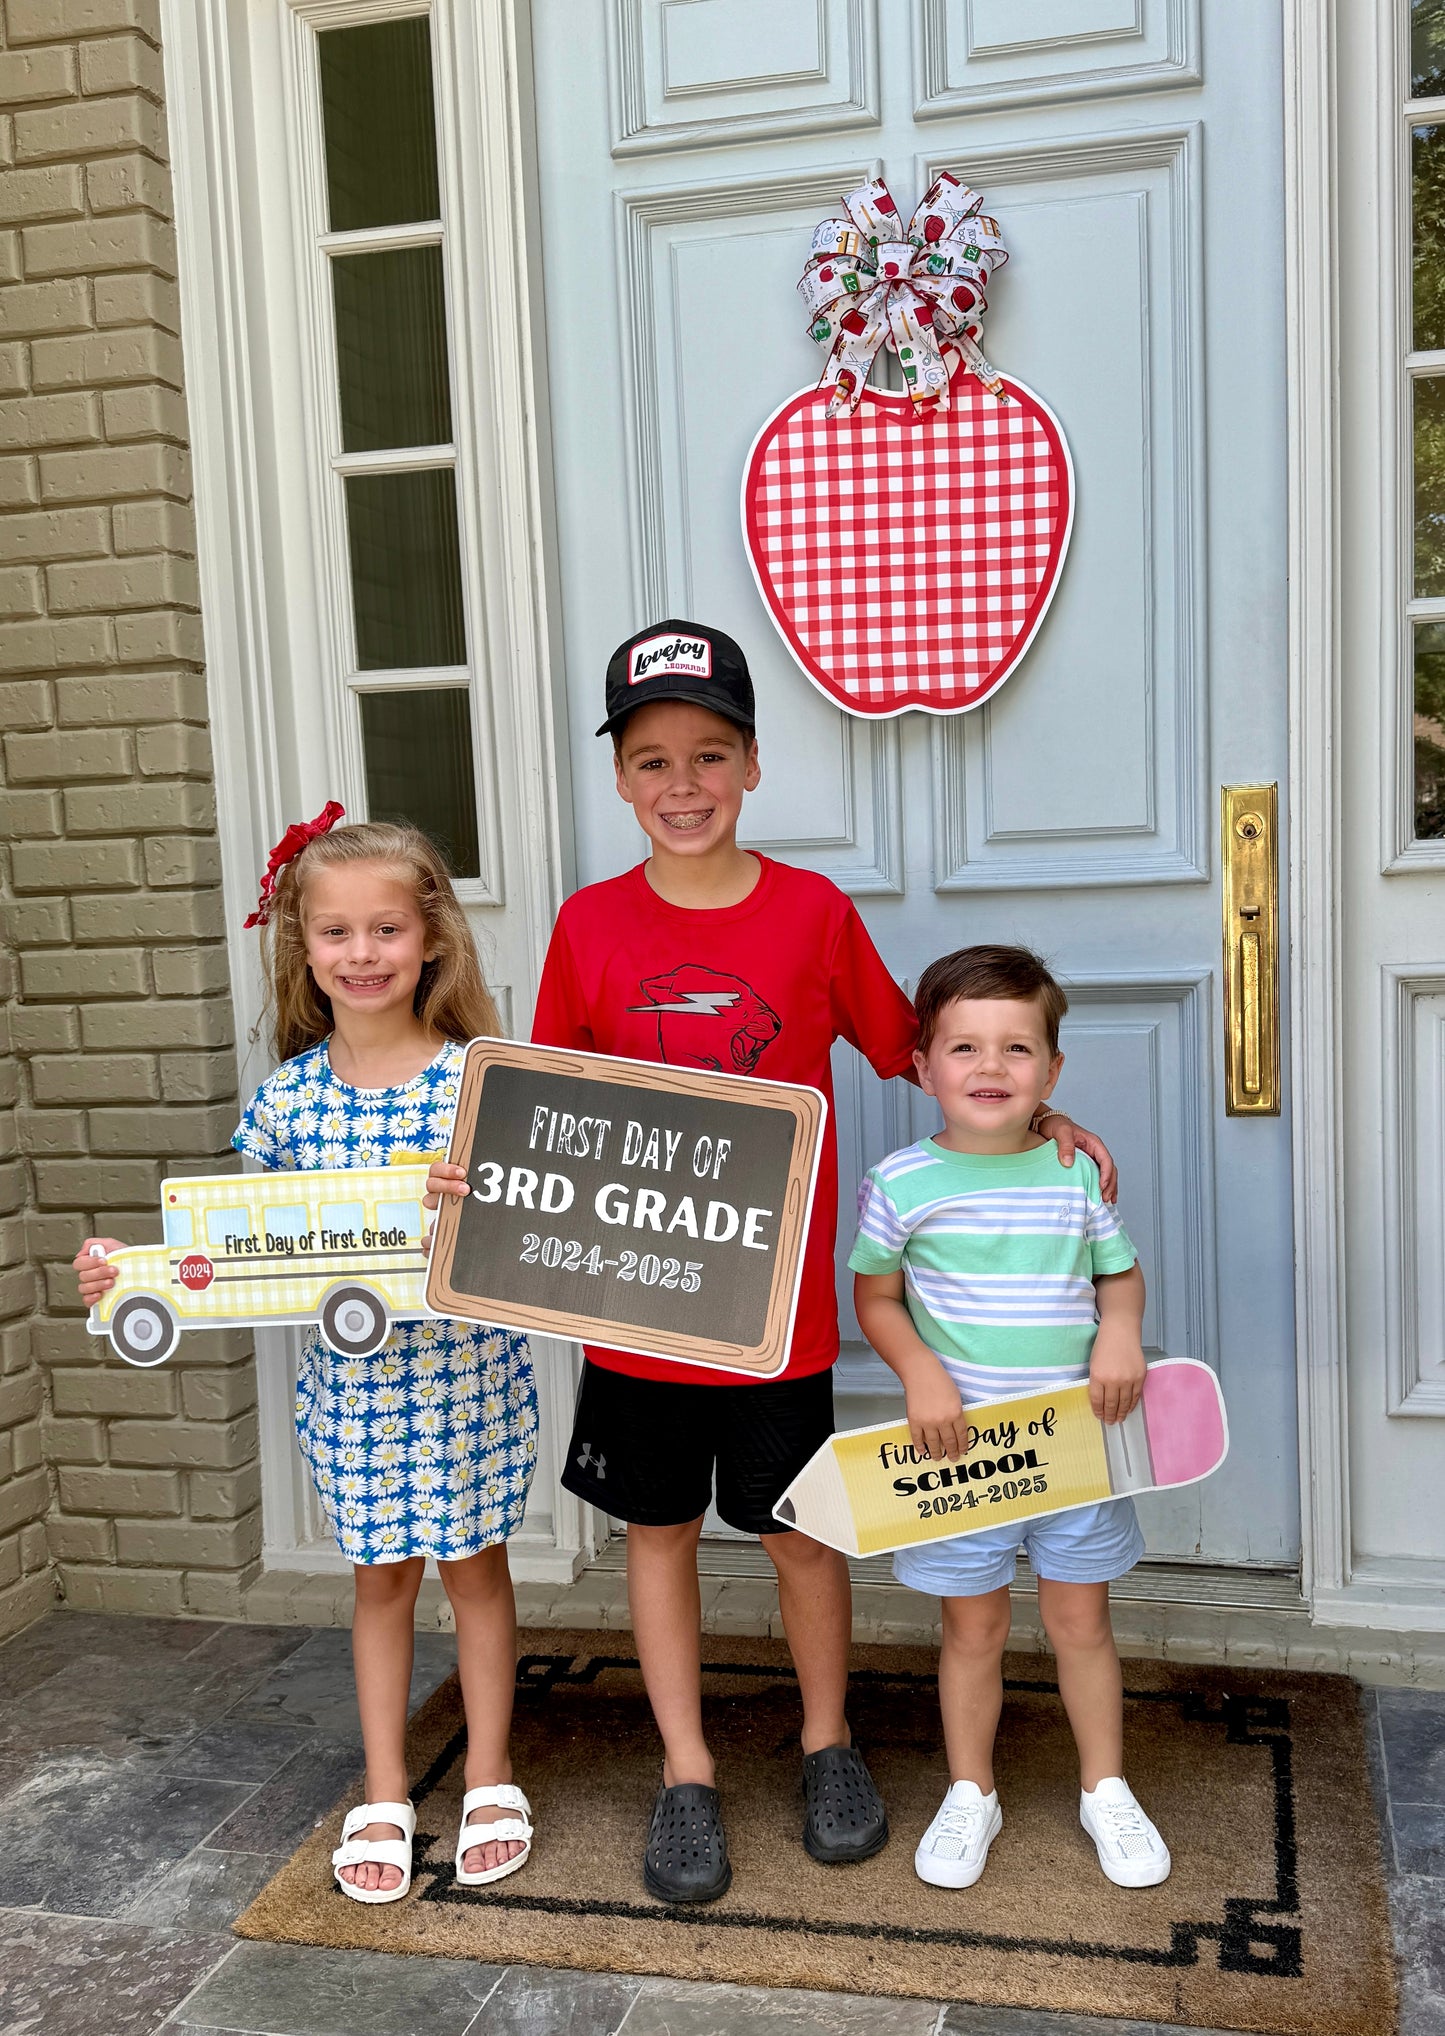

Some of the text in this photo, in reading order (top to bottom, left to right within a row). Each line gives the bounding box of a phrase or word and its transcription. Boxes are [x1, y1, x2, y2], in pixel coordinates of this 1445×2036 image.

[633, 638, 706, 678] Lovejoy
[664, 662, 706, 674] LEOPARDS
[528, 1105, 732, 1180] FIRST DAY OF
[472, 1161, 774, 1251] 3RD GRADE
[225, 1226, 407, 1256] First Day of First Grade
[182, 1263, 211, 1279] 2024
[519, 1233, 704, 1293] 2024-2025
[1028, 1407, 1058, 1437] of
[892, 1448, 1049, 1497] SCHOOL
[917, 1473, 1048, 1519] 2024-2025
